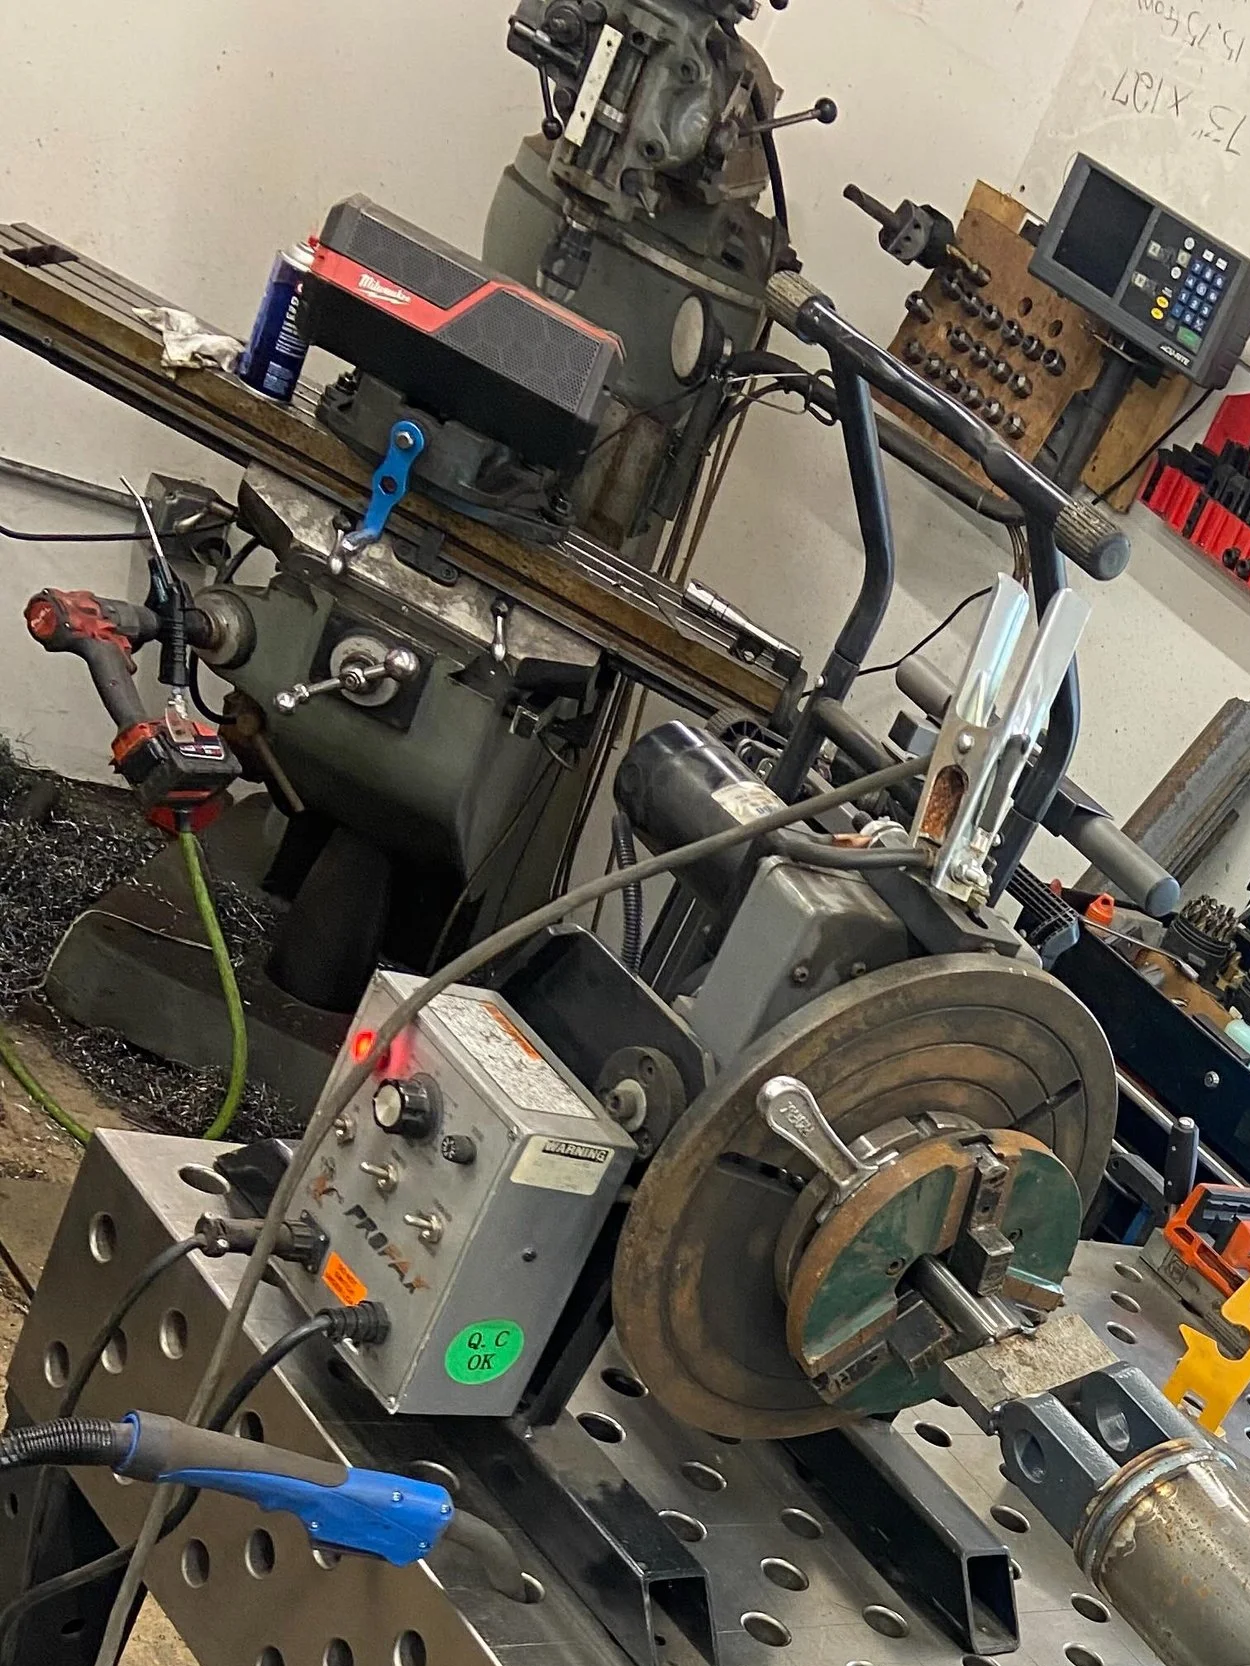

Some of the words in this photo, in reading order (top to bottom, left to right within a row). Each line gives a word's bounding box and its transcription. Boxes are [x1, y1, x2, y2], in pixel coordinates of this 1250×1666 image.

[358, 273, 412, 303] Milwaukee
[544, 1140, 606, 1163] WARNING
[467, 1353, 497, 1371] OK
